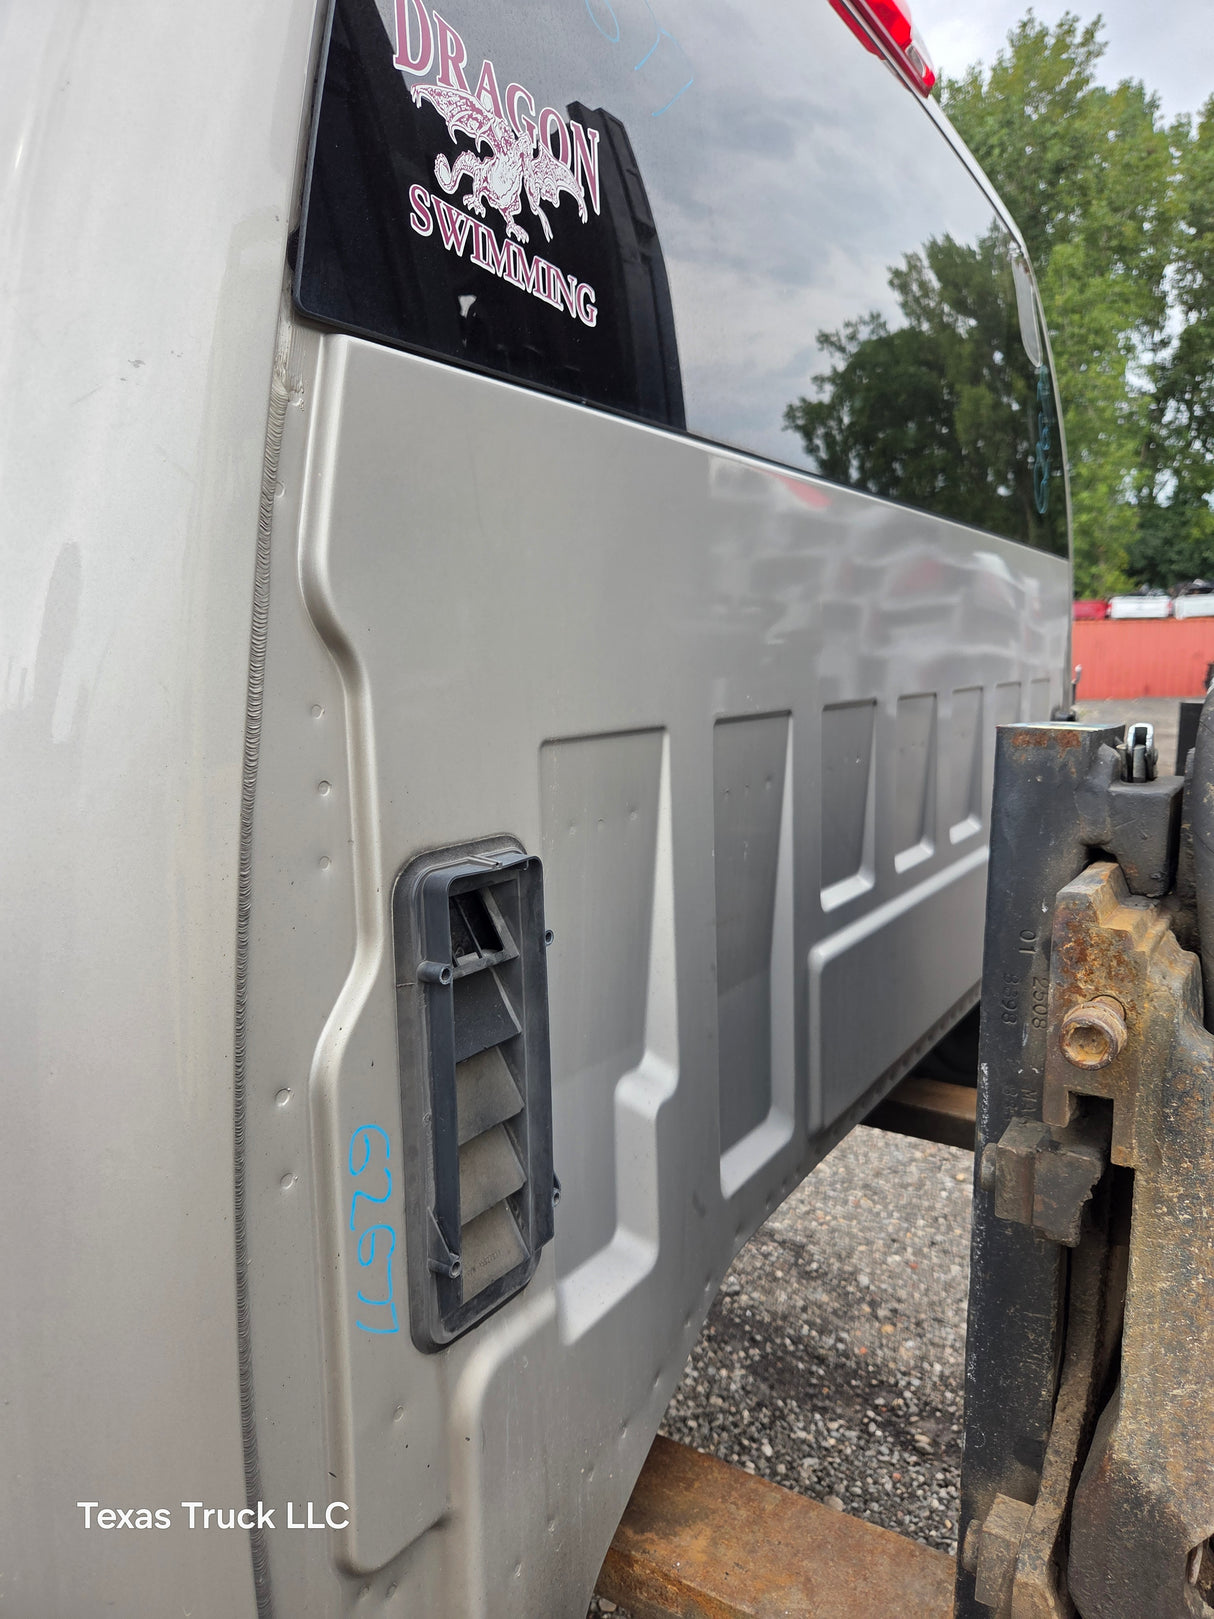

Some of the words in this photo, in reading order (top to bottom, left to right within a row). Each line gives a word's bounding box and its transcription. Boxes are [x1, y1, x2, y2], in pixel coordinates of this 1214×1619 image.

[393, 0, 600, 216] DRAGON
[409, 184, 597, 328] SWIMMING
[1032, 977, 1049, 1030] 2508
